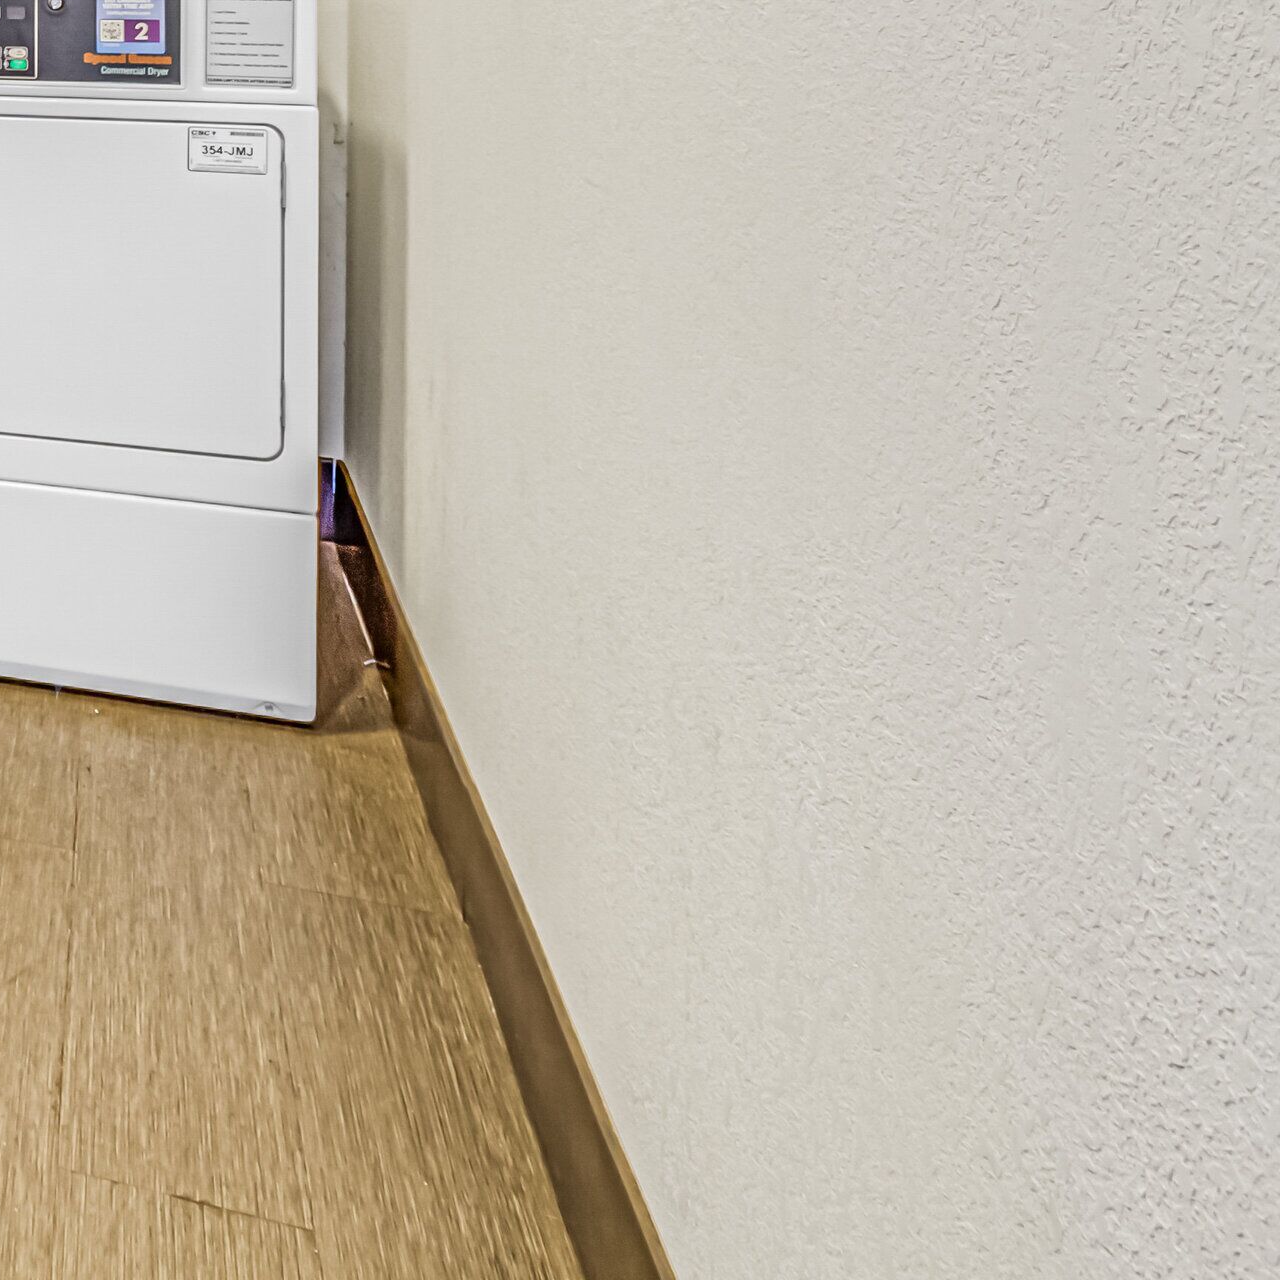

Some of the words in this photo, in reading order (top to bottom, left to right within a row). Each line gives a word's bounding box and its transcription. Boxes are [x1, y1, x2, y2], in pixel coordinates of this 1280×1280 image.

[134, 22, 149, 40] 2
[101, 65, 146, 75] Commercial
[147, 67, 169, 77] Dryer
[202, 145, 253, 156] 354-JMJ
